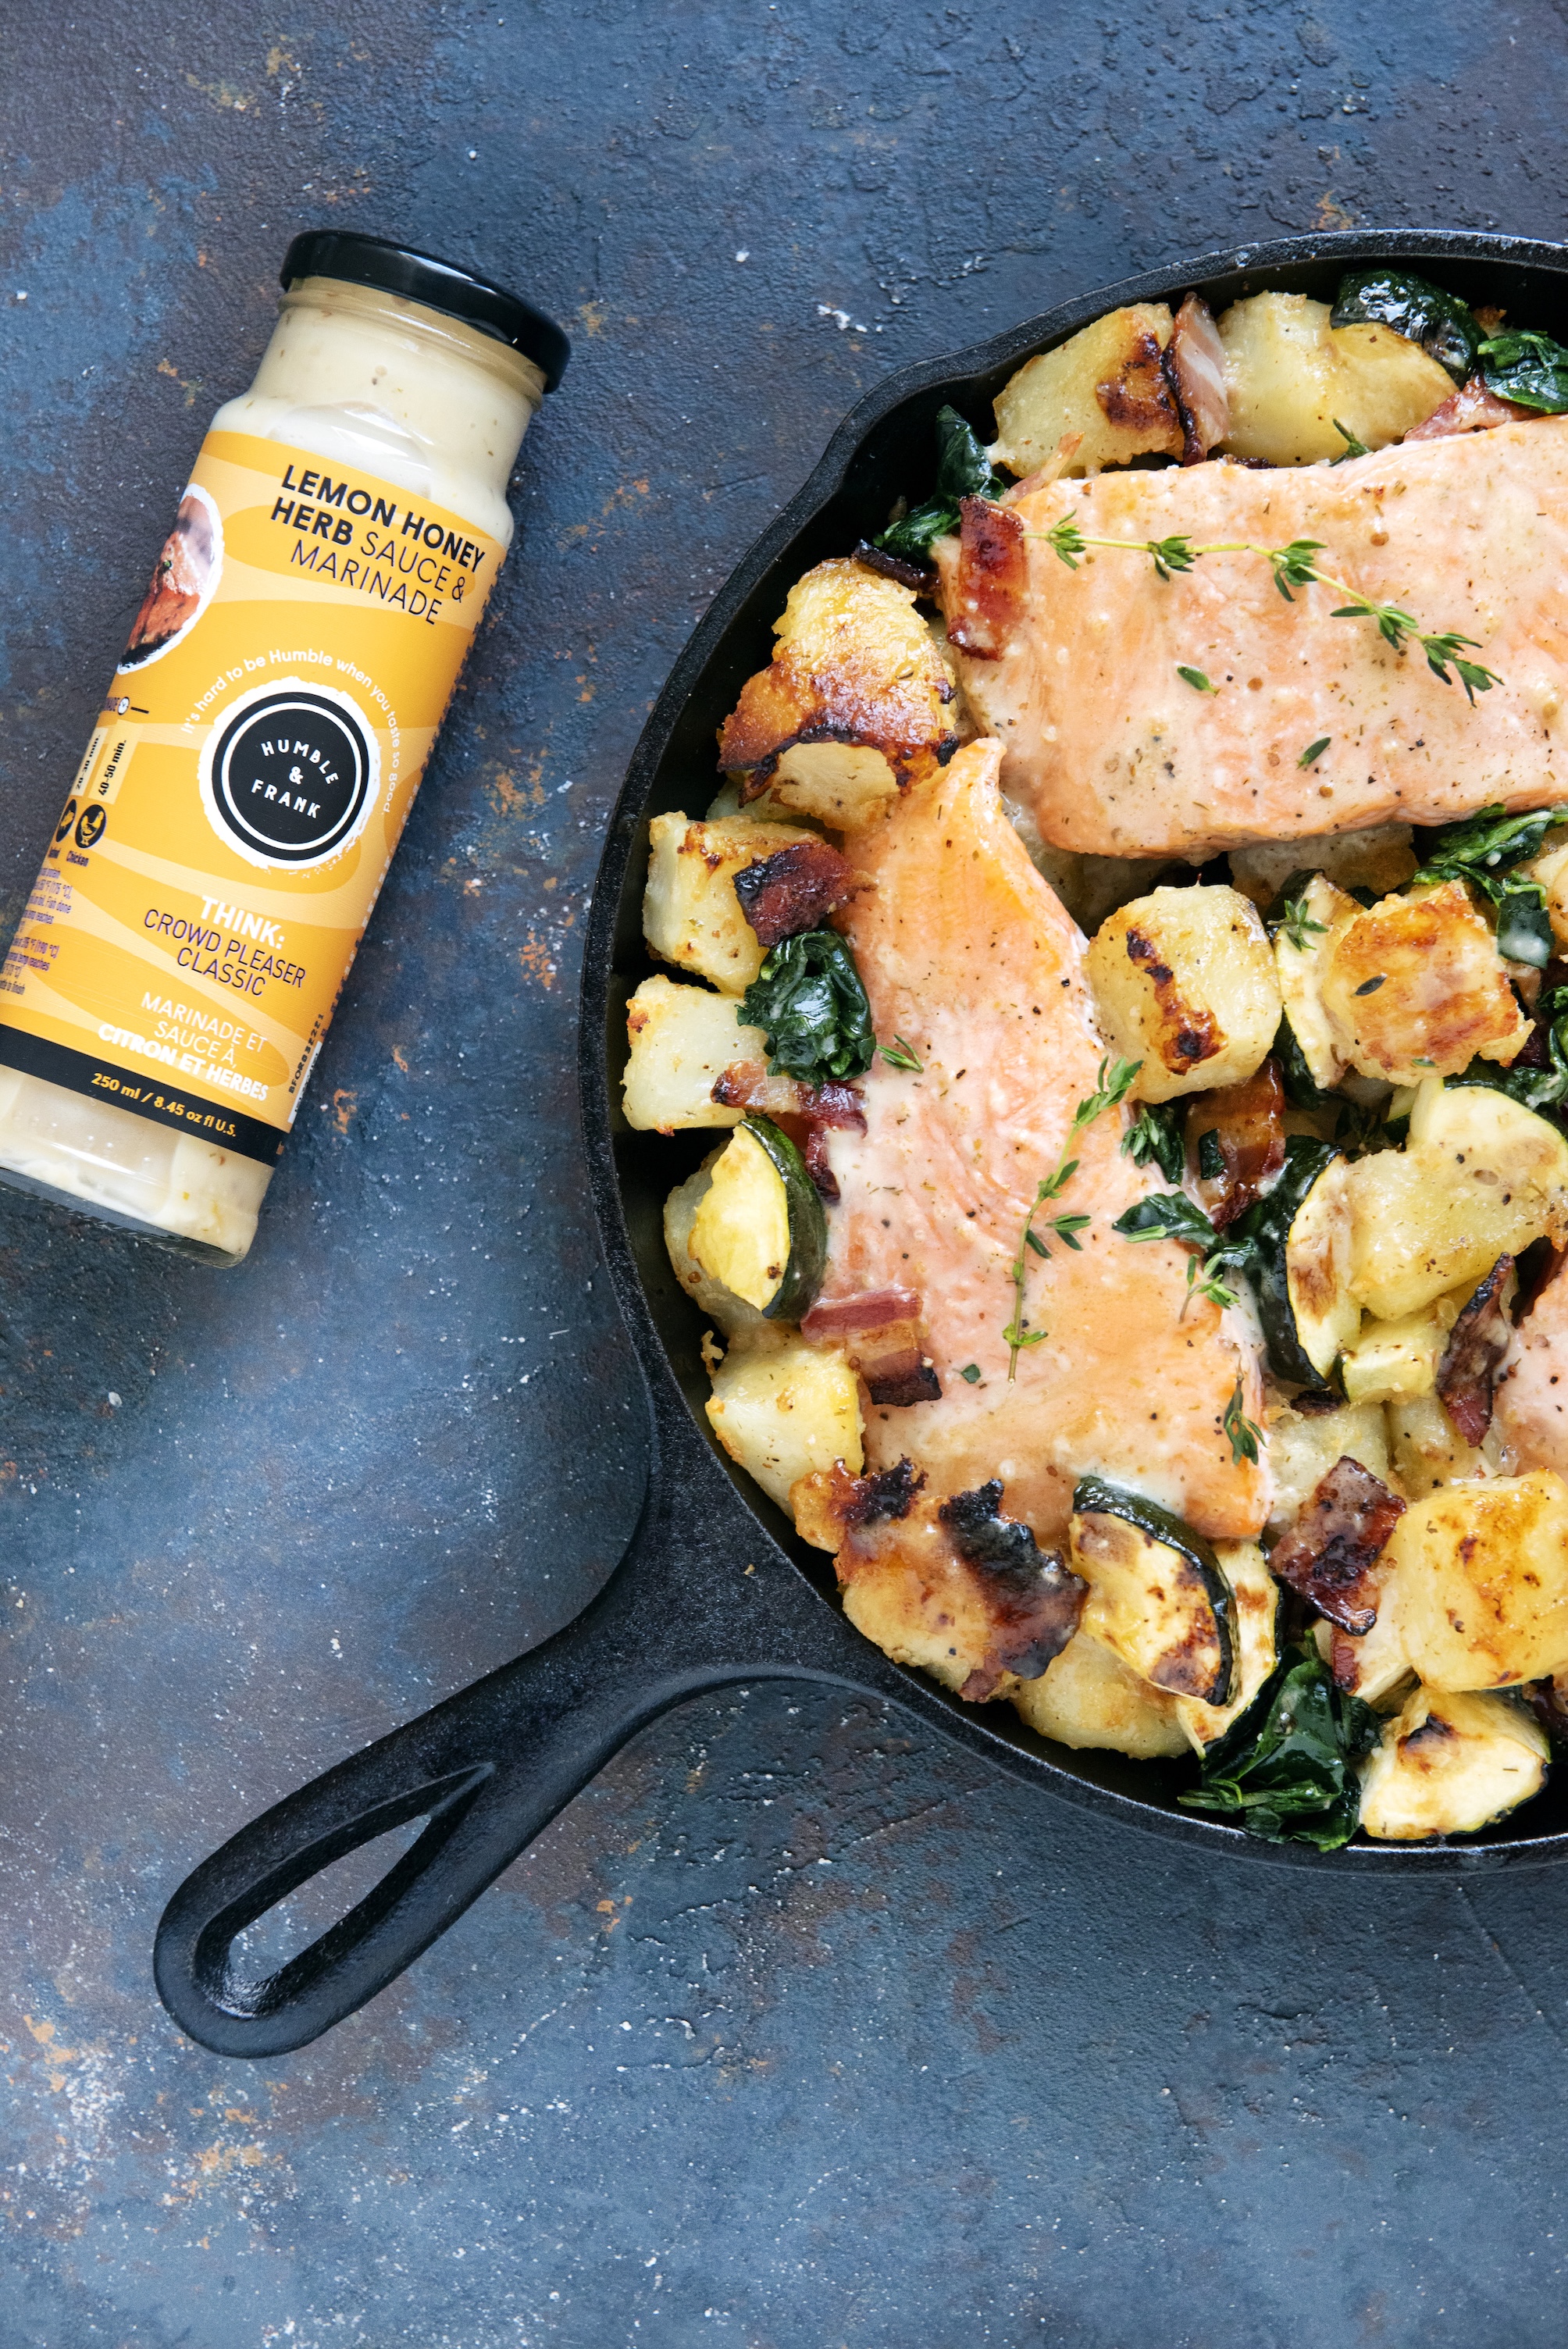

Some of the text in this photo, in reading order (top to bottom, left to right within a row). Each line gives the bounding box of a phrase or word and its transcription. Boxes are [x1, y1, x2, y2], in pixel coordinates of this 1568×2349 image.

[281, 465, 486, 572] LEMON HONEY
[270, 497, 353, 545] HERB
[360, 531, 451, 592] SAUCE
[451, 576, 465, 603] &
[290, 539, 442, 625] MARINADE
[181, 712, 201, 734] It's
[194, 676, 228, 711] hard
[226, 666, 243, 682] to
[244, 656, 266, 672] be
[269, 648, 333, 666] Humble
[336, 658, 373, 688] when
[369, 685, 390, 711] you
[383, 711, 400, 747] taste
[392, 751, 400, 768] so
[98, 740, 127, 796] 40-50 min.
[261, 740, 339, 785] HUMBLE
[288, 766, 304, 785] &
[251, 779, 321, 818] FRANK
[144, 909, 306, 988] CROWD PLEASER
[201, 895, 284, 950] THINK:
[177, 947, 265, 996] CLASSIC
[141, 992, 267, 1053] MARINADE ET
[154, 1021, 221, 1058] SAUCE
[98, 1024, 178, 1066] CITRON
[178, 1053, 206, 1075] ET
[205, 1063, 269, 1101] HERBES
[91, 1072, 237, 1138] 250 ml / 8.45 oz fl U.S.
